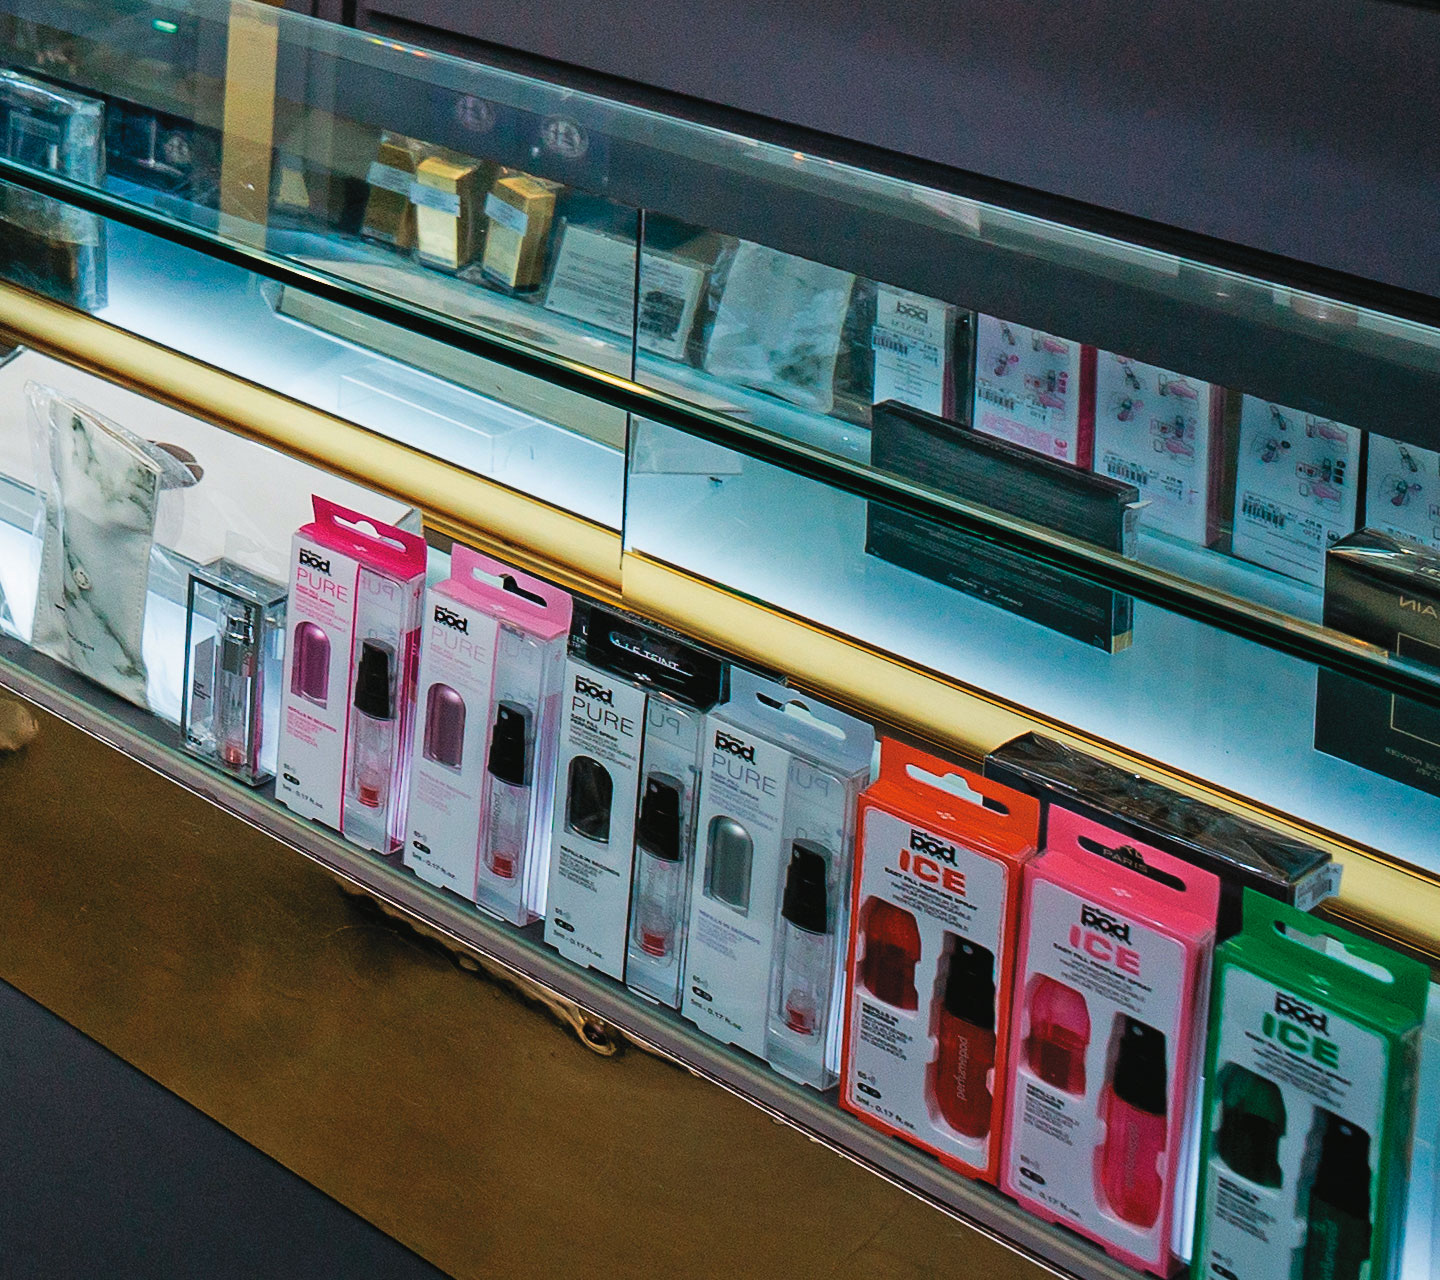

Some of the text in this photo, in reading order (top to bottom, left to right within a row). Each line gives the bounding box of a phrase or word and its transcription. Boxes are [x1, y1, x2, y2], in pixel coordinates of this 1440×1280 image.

[296, 566, 348, 603] PURE
[430, 625, 486, 664] PURE
[572, 695, 635, 737] PURE
[712, 752, 777, 797] PURE
[909, 831, 958, 868] pod
[898, 847, 967, 898] ICE
[1080, 906, 1133, 946] pod
[1067, 923, 1142, 977] ICE
[1274, 993, 1330, 1037] pod
[1262, 1011, 1339, 1070] ICE
